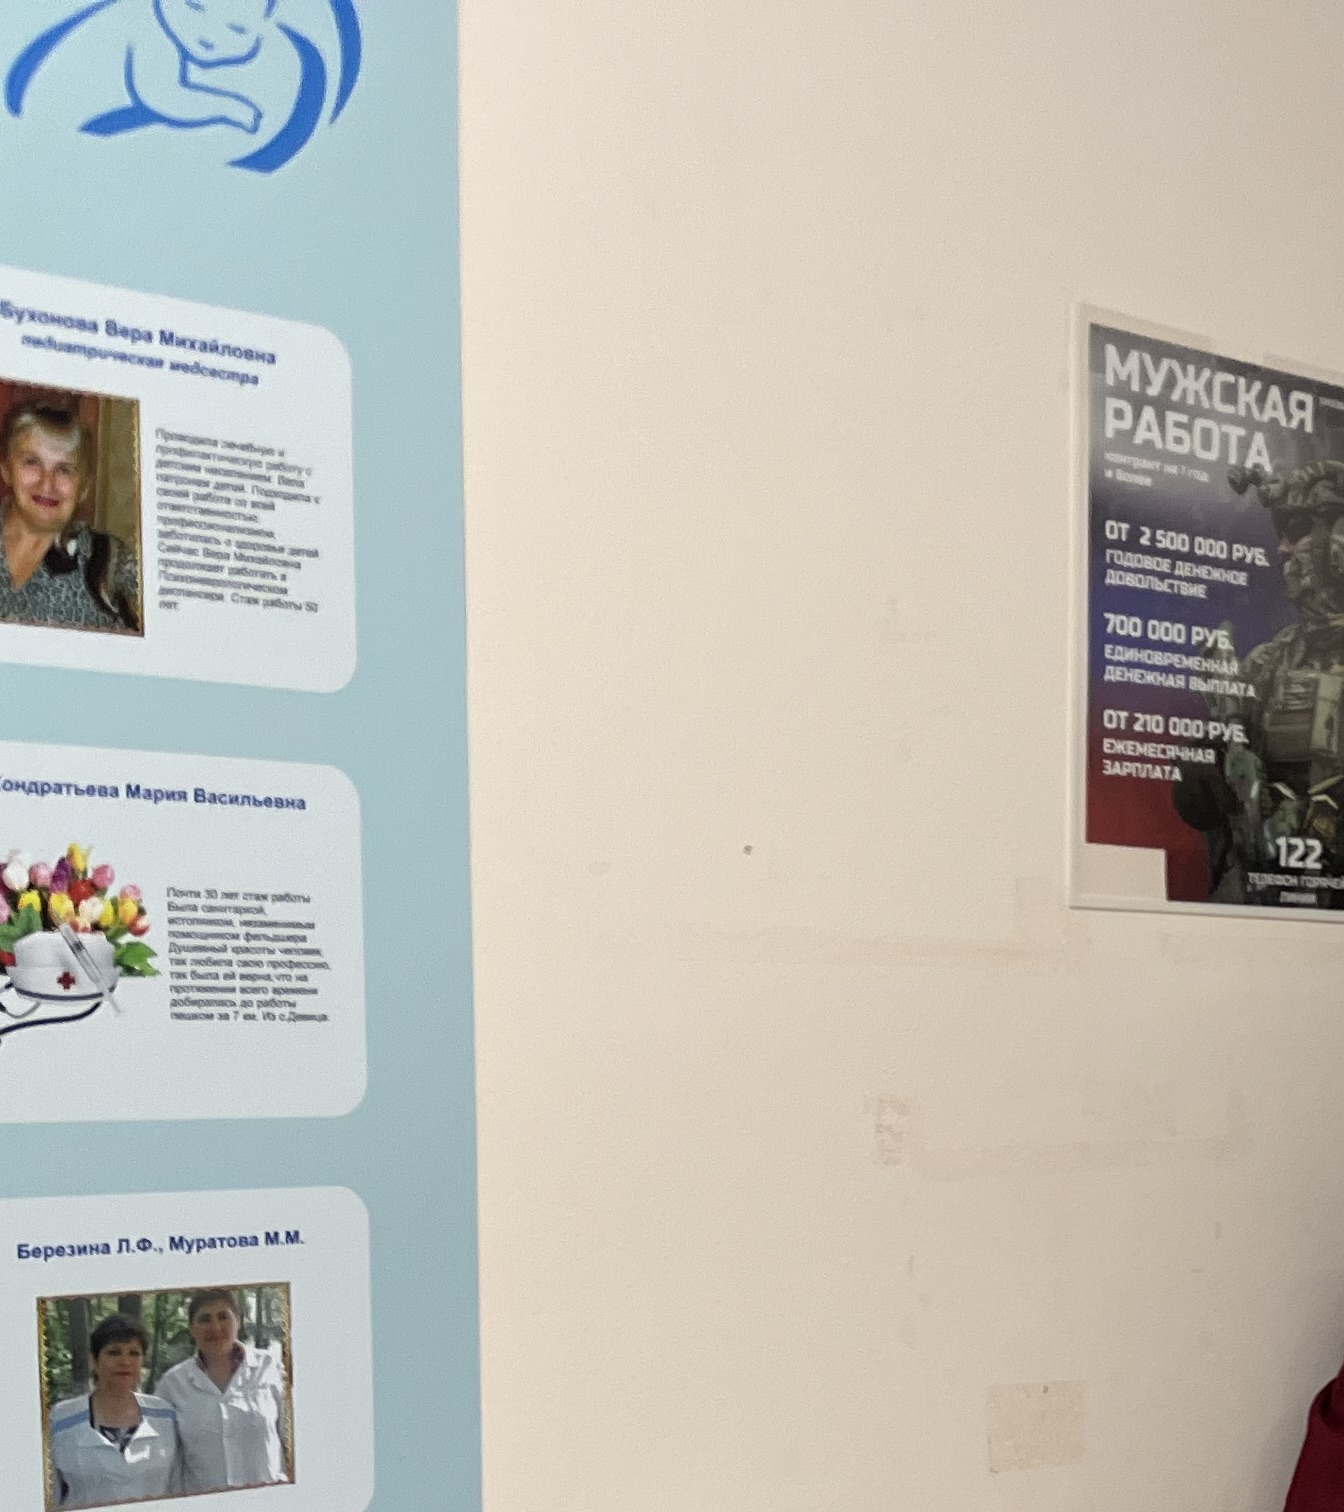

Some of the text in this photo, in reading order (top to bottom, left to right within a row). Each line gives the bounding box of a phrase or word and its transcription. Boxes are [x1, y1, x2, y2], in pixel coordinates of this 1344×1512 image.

[105, 319, 153, 343] Вера
[159, 329, 277, 365] Михайловна
[1104, 343, 1313, 433] МУЖСКАЯ
[1106, 396, 1272, 473] РАБОТА
[1105, 520, 1269, 567] ОТ 2 500 000 РУБ.
[1104, 569, 1207, 599] ДОВОЛЬСТВИЕ
[1106, 549, 1248, 586] ГОДОВОЕ ДЕНЕЖНОЕ
[1103, 613, 1234, 650] 700 000 РУБ.
[1104, 644, 1238, 676] ЕДИНОВРЕМЕННАЯ
[1104, 665, 1256, 697] ДЕНЕЖНАЯ ВЫПЛАТА
[1103, 709, 1249, 743] ОТ 210 000 РУБ.
[1103, 738, 1215, 764] ЕЖЕМЕСЯЧНАЯ
[1102, 759, 1182, 781] ЗАРПЛАТА
[0, 777, 306, 810] ондратьева Мария Васильевна
[1276, 836, 1322, 869] 122
[17, 1230, 304, 1262] Березина Л.Ф., Муратова М.М.
